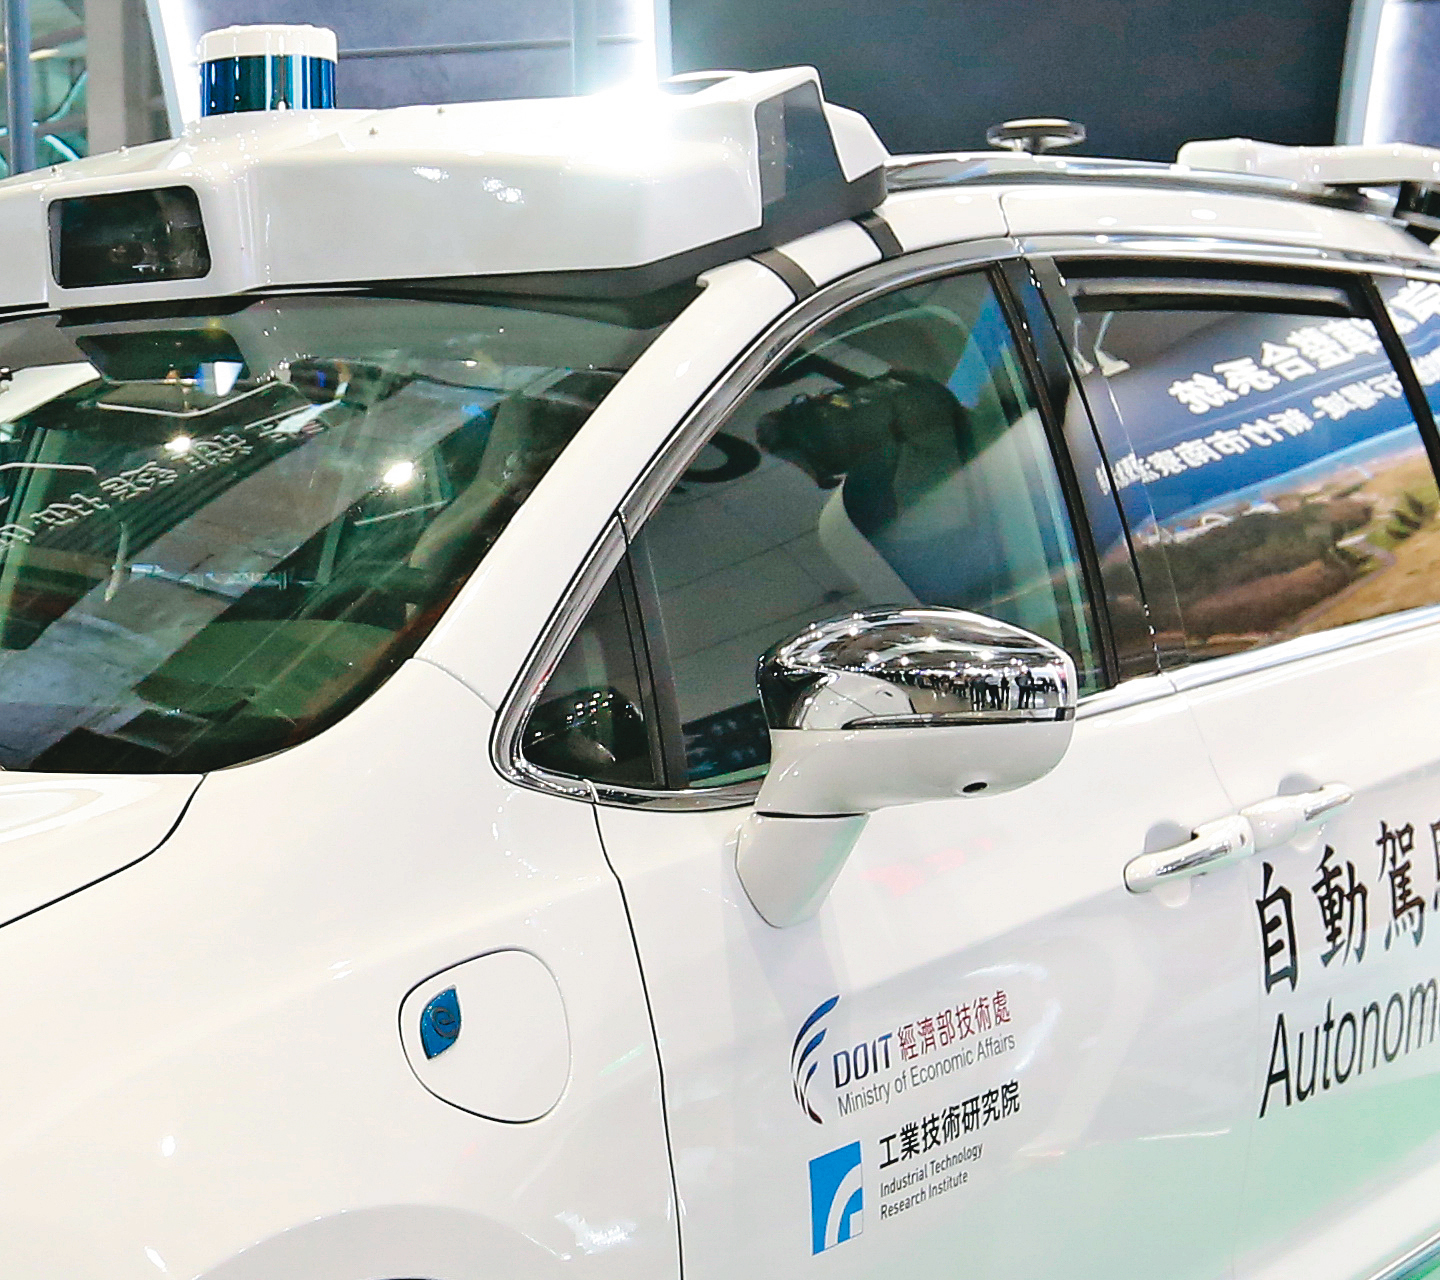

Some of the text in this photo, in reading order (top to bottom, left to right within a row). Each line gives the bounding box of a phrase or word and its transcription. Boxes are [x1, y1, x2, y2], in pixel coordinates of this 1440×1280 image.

[833, 989, 1012, 1090] DOIT 經濟部技術處
[837, 1032, 1017, 1118] Ministry of Economic Affairs
[879, 1079, 1021, 1170] 工業技術研究院
[879, 1142, 984, 1198] Industrial Technology
[879, 1169, 969, 1220] Research Institute
